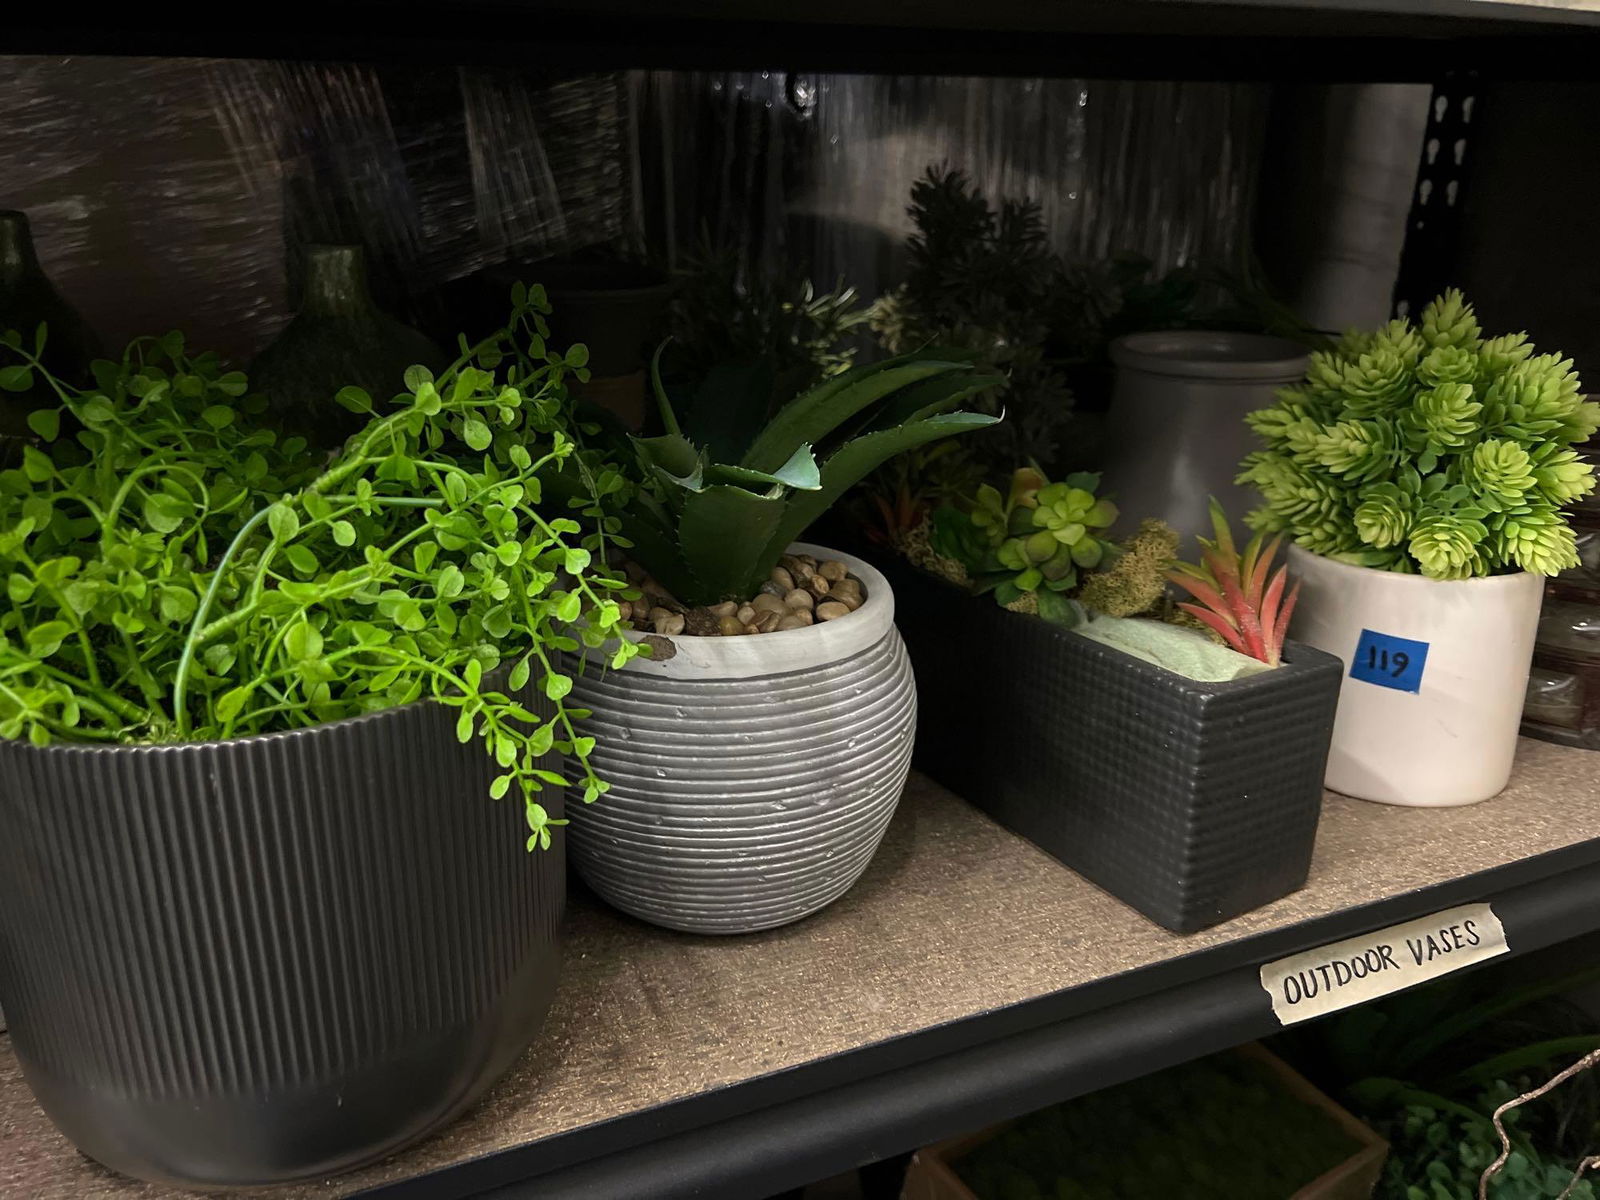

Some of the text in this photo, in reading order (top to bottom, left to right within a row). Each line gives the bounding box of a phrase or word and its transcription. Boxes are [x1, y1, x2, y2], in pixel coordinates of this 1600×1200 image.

[1369, 645, 1409, 678] 119
[1284, 920, 1480, 1004] OUTDOOR VASES
